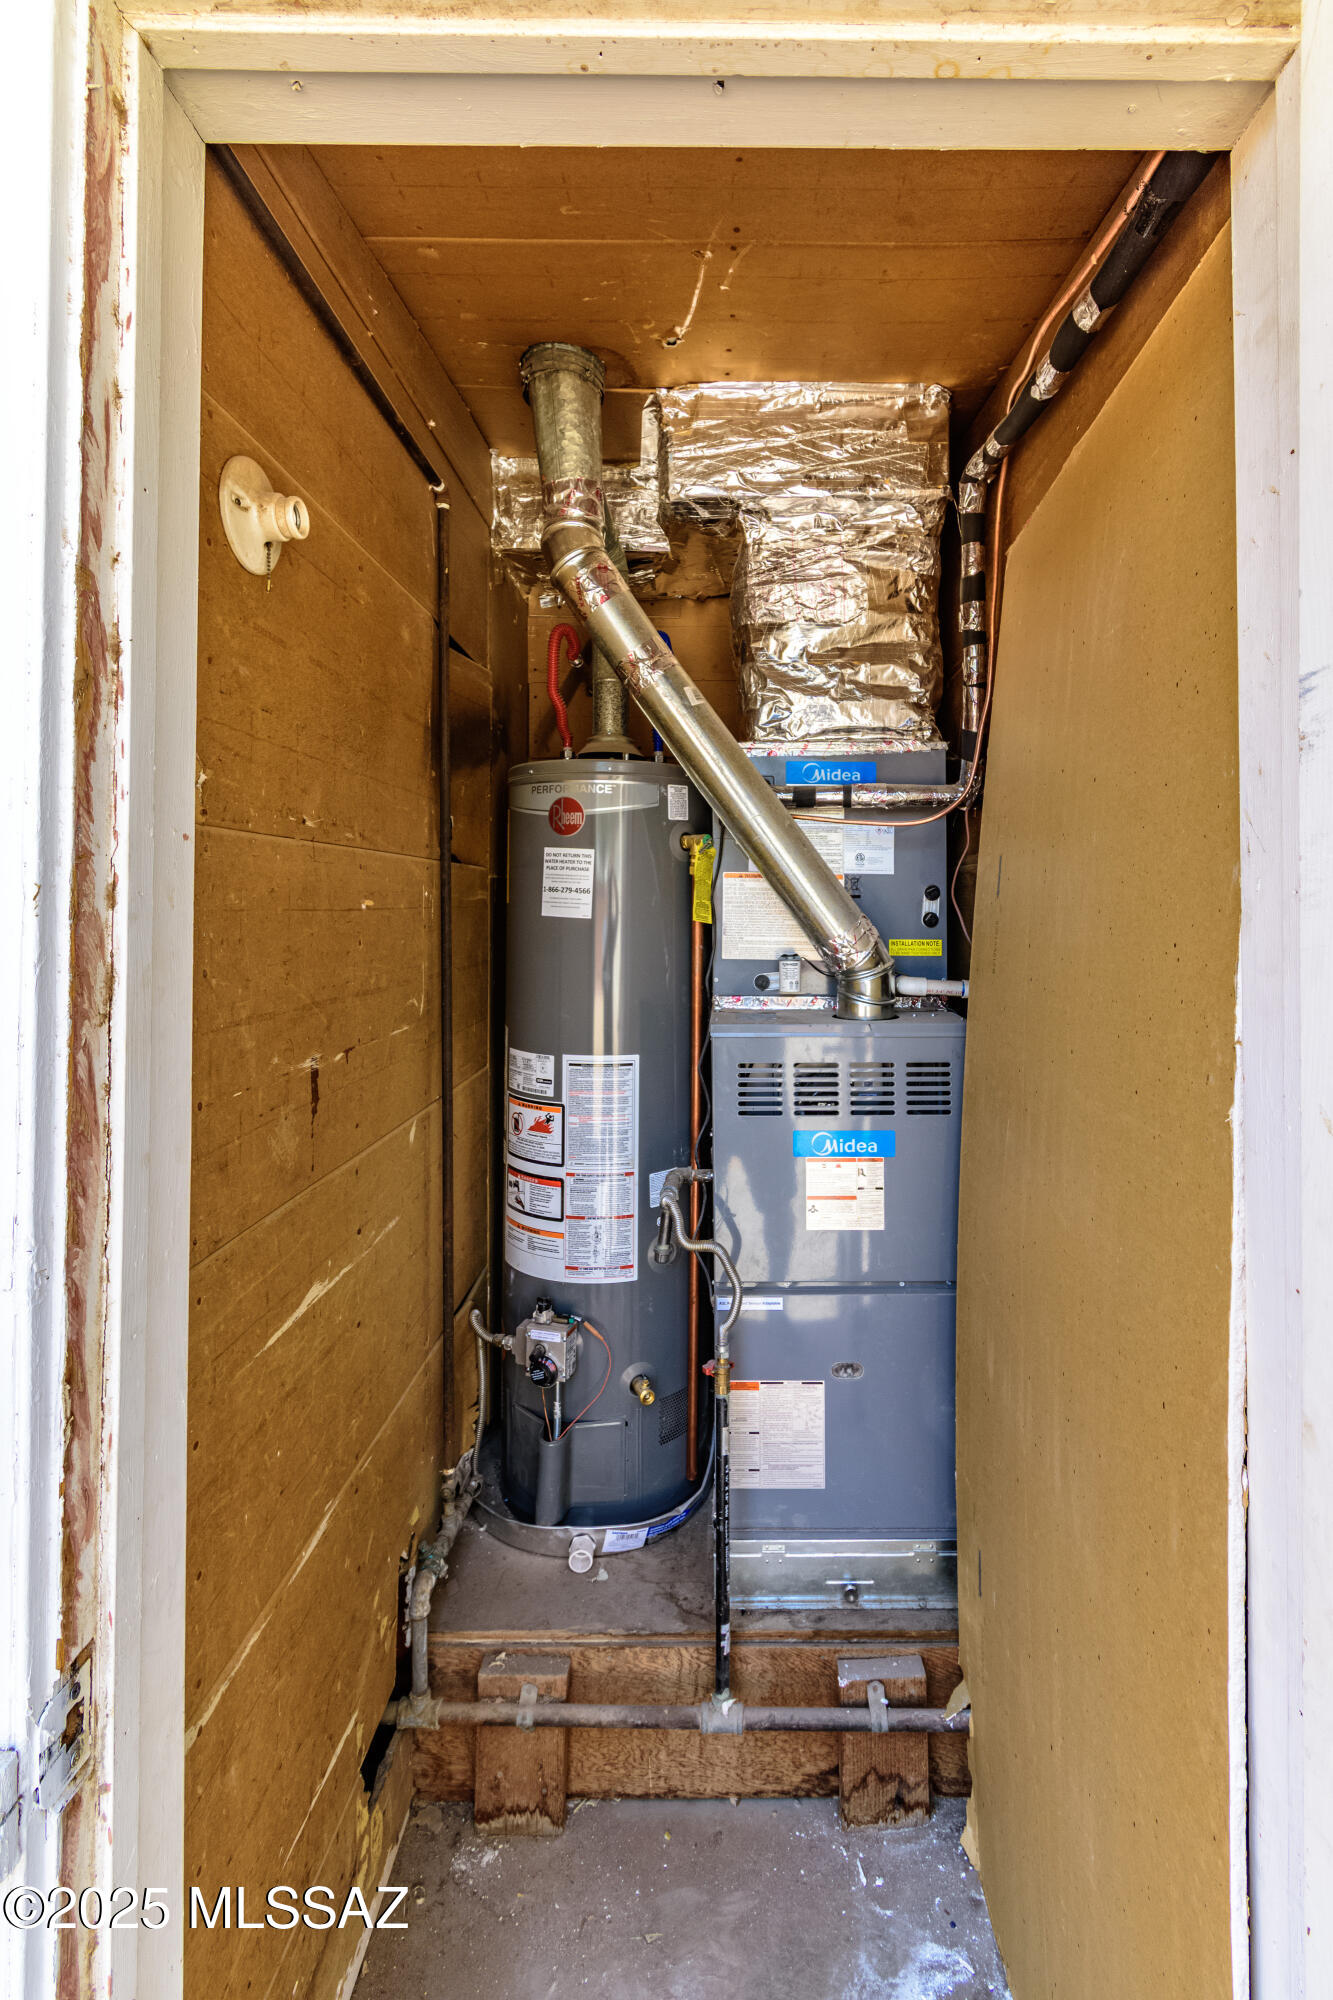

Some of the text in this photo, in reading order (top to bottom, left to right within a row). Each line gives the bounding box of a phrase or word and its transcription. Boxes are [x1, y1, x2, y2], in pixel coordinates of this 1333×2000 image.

[806, 766, 861, 782] Midea
[552, 798, 583, 830] Rheem
[543, 886, 591, 895] 1-866-279-4566
[816, 1135, 878, 1154] Midea
